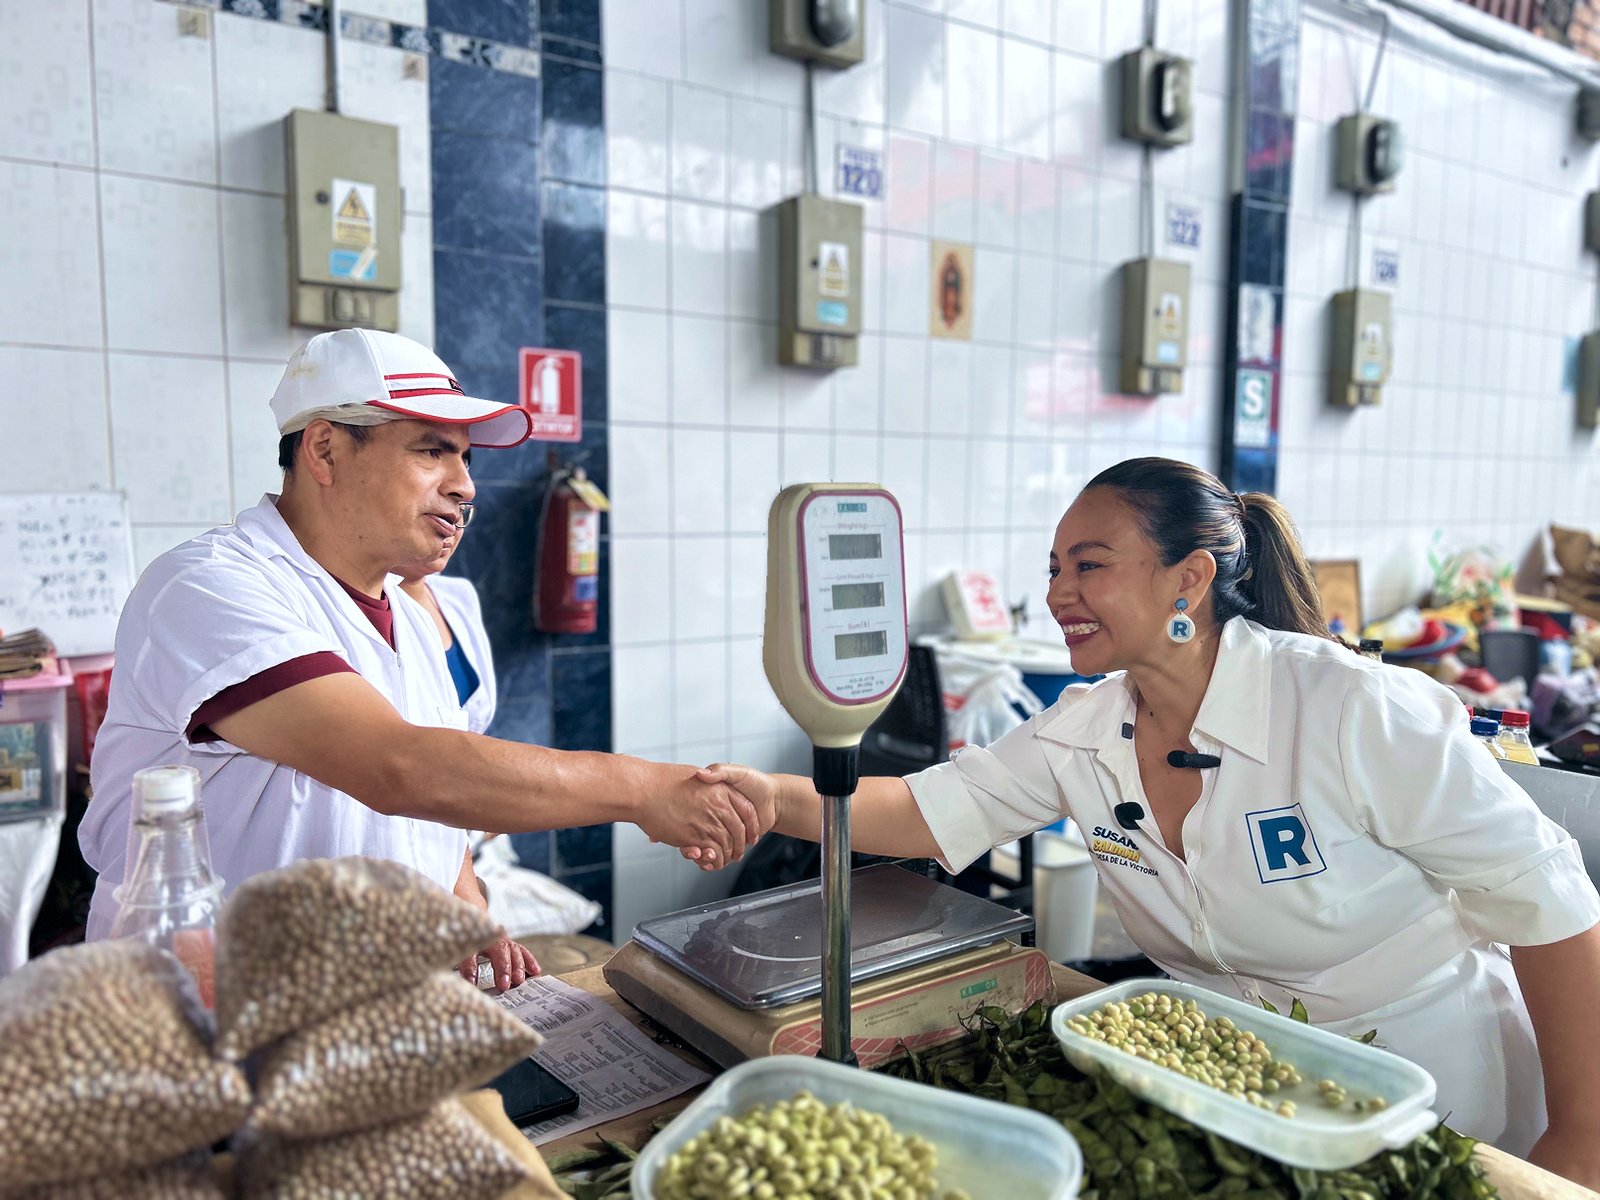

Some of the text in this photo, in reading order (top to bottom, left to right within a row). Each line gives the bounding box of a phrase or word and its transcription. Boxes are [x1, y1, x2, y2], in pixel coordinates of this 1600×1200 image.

[843, 164, 882, 197] 120
[1244, 379, 1263, 415] S
[1173, 621, 1188, 636] R
[1258, 816, 1311, 870] R
[1110, 856, 1119, 865] DE
[1119, 859, 1128, 867] LA
[1129, 862, 1159, 877] VICTORIA
